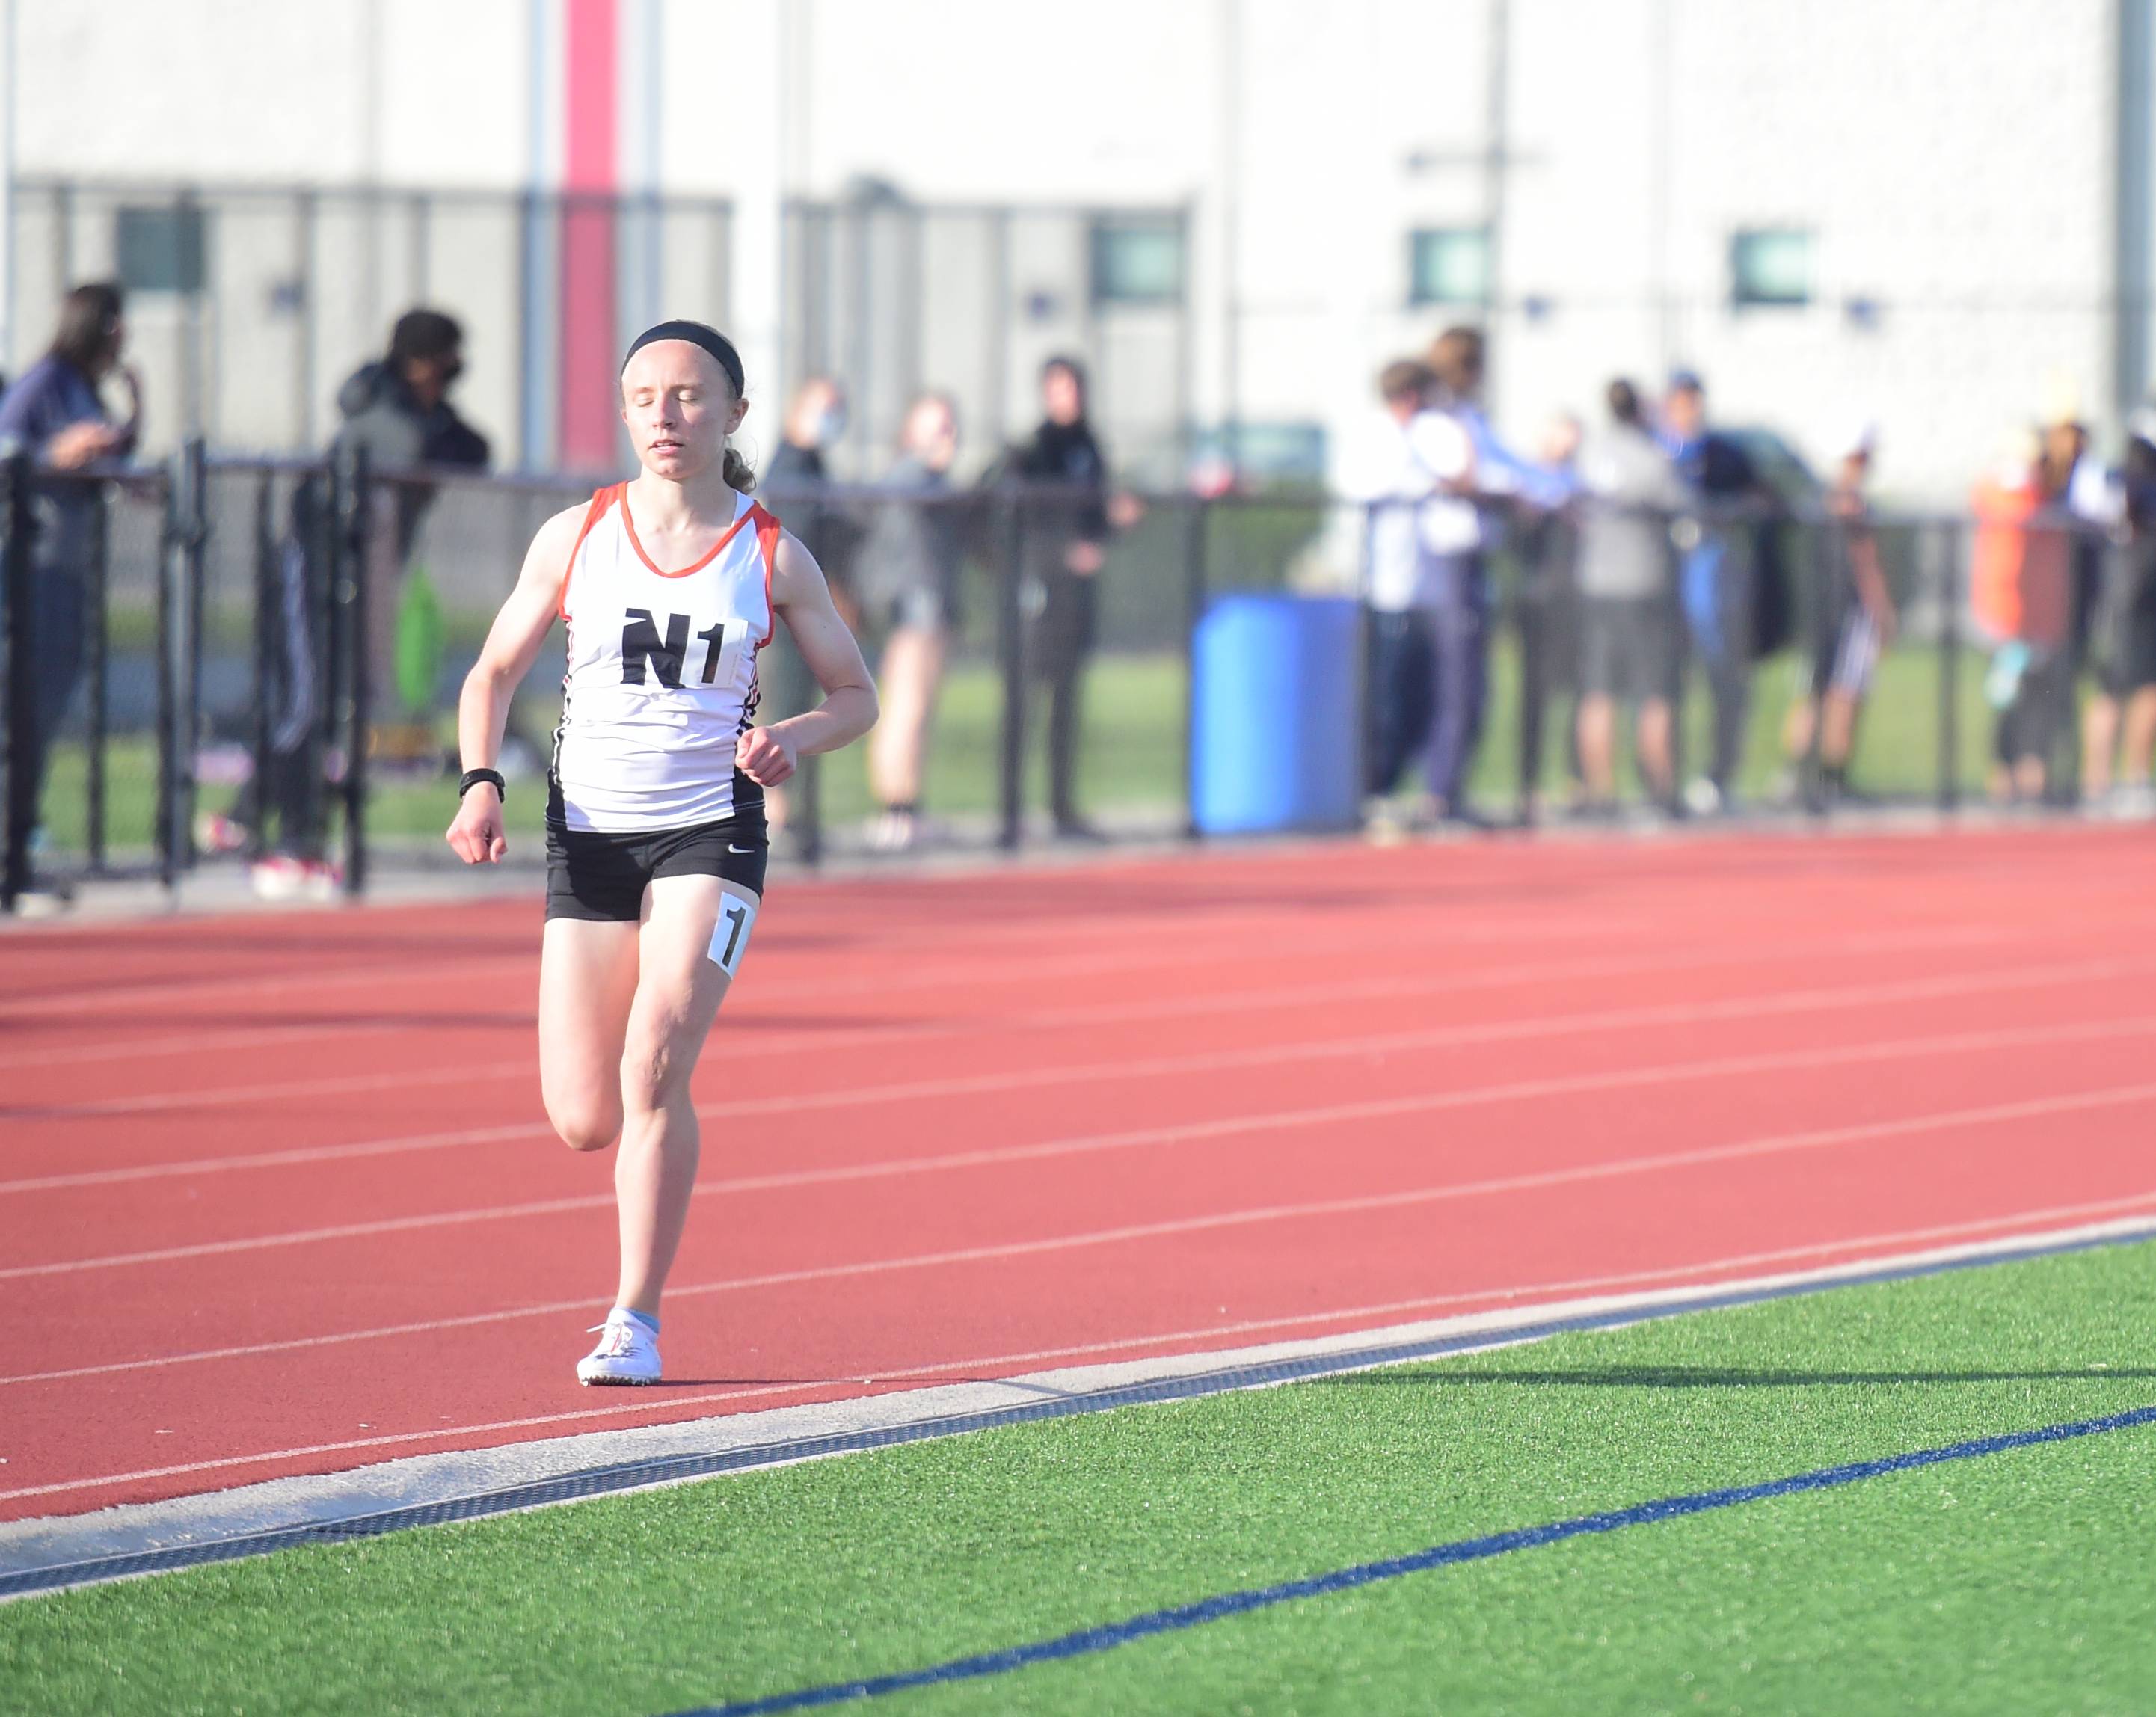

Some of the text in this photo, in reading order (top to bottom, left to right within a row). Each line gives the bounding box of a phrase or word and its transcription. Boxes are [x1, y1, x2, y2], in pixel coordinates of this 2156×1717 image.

[620, 607, 691, 689] N
[697, 622, 725, 684] 1
[722, 906, 746, 968] 1
